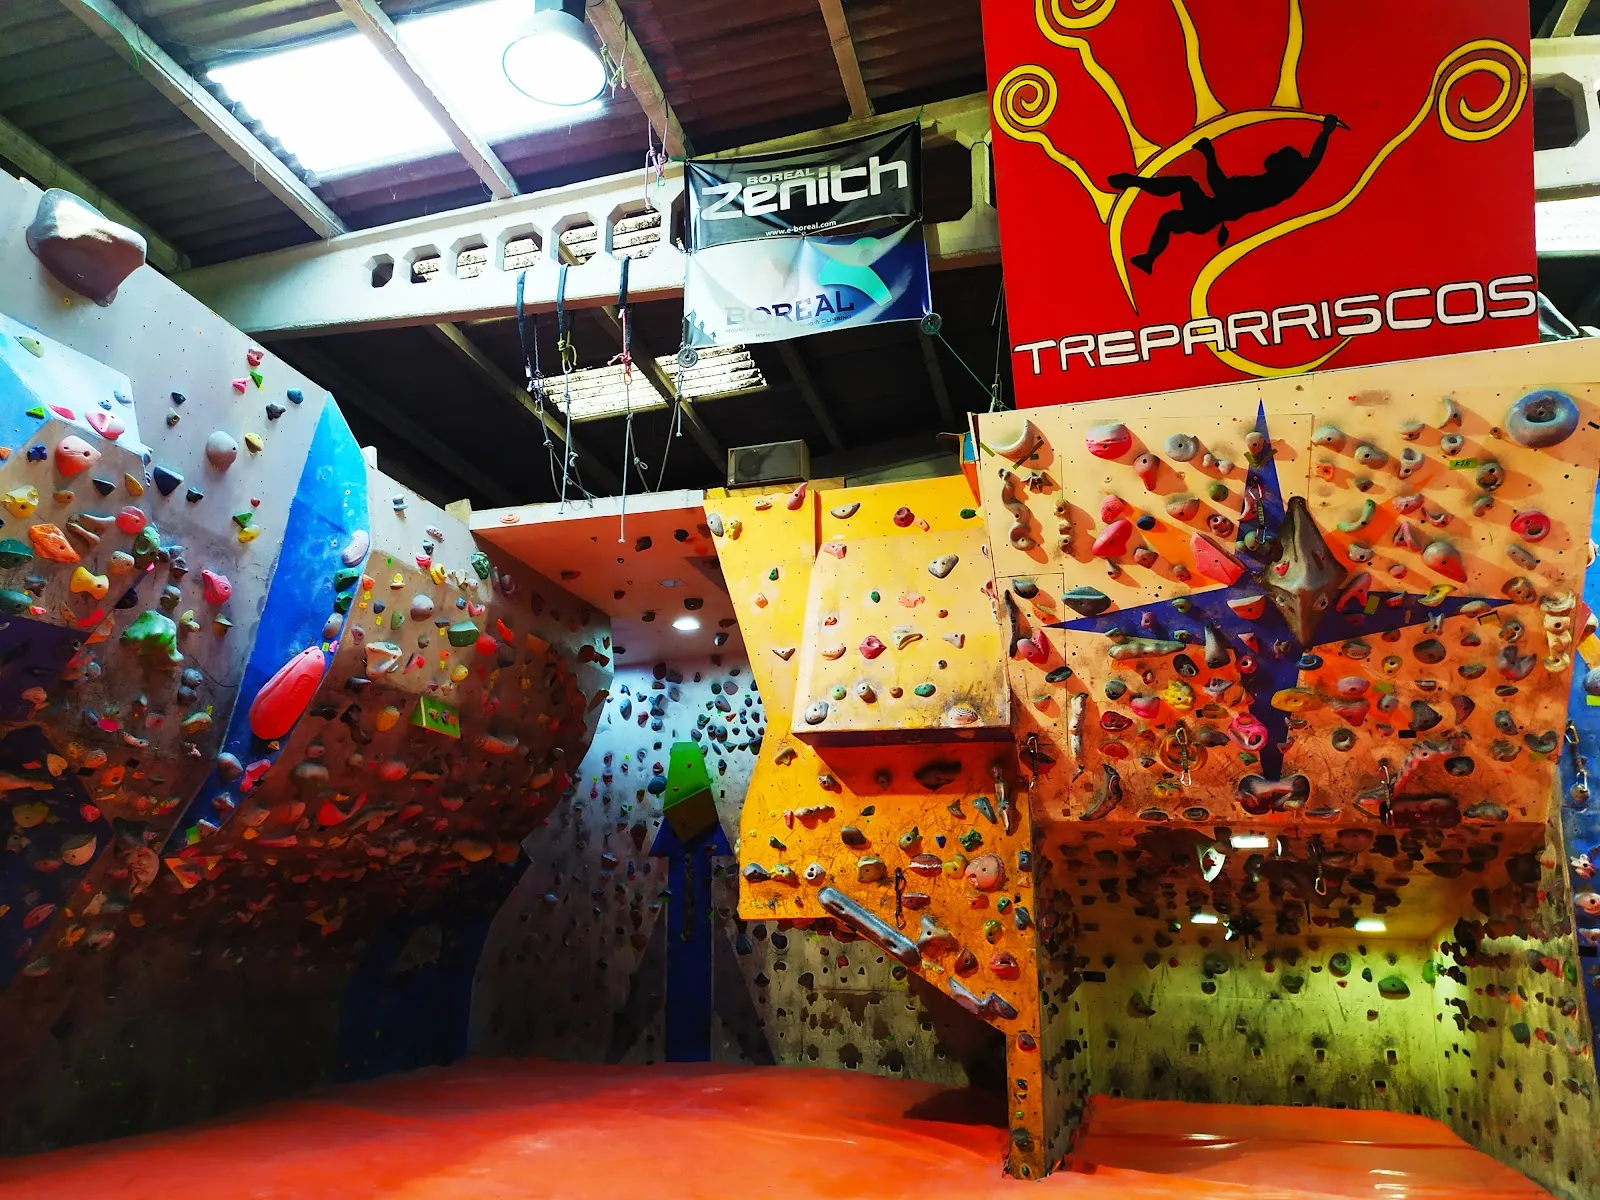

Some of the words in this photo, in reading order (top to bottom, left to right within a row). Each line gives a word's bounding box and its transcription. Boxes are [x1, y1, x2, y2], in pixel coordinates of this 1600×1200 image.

[746, 167, 815, 185] BOREAL
[765, 220, 837, 237] www.e-boreal.com
[724, 290, 855, 326] BOREAL
[1013, 274, 1537, 375] TREPARRISCOS
